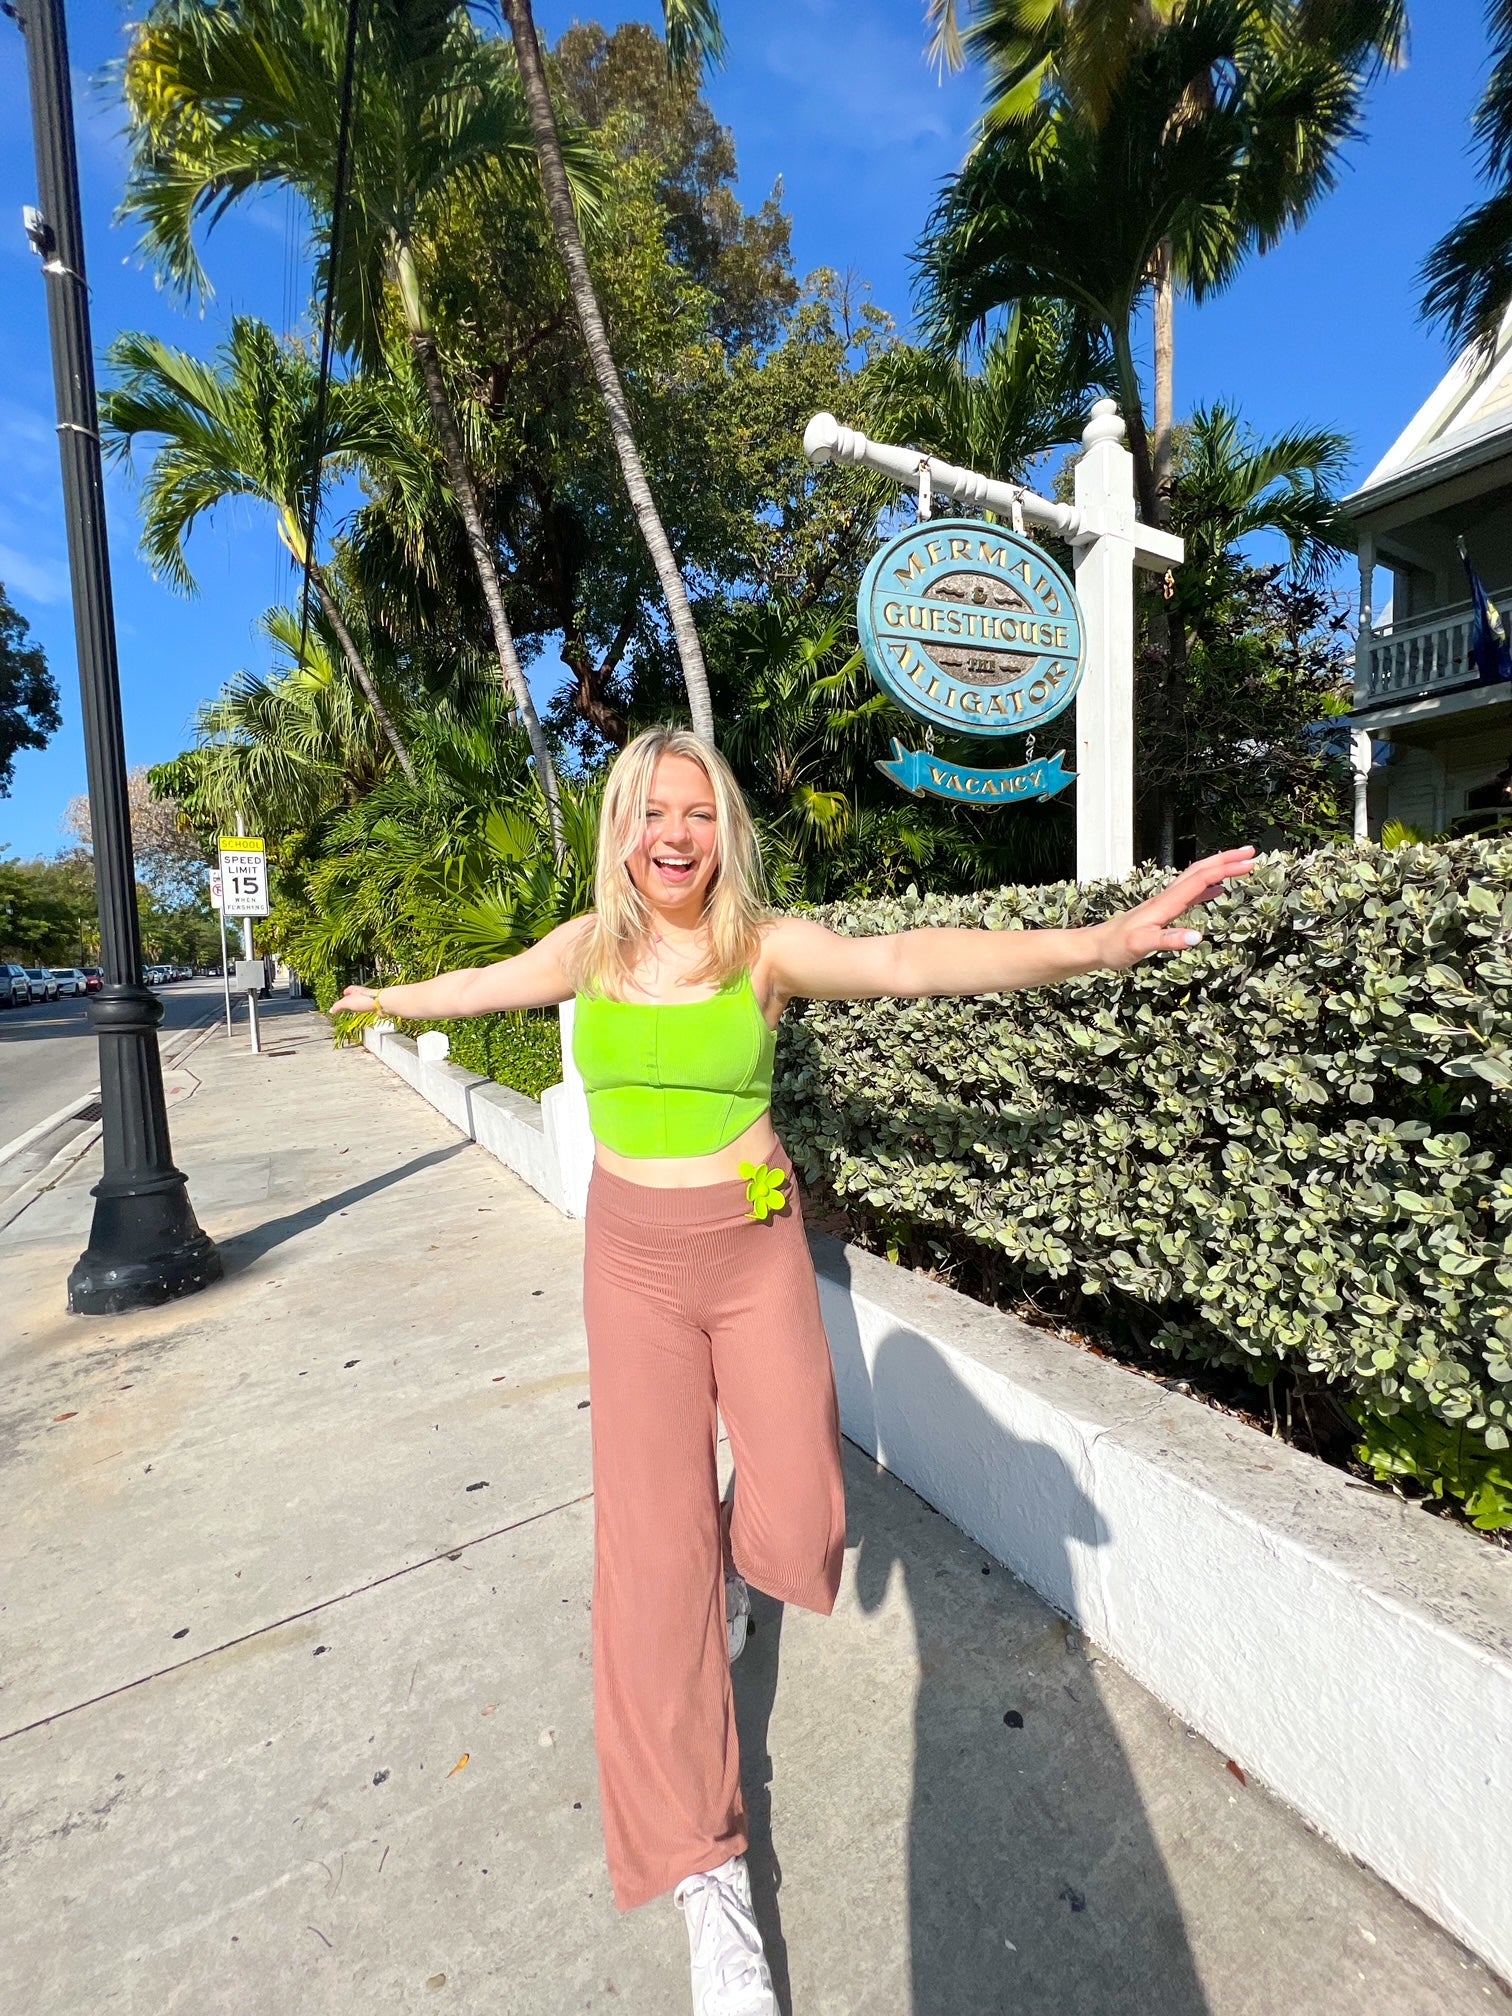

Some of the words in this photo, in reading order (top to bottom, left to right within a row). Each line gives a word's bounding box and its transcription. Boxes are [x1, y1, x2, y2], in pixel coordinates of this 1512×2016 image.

[893, 538, 1062, 616] MERMAID
[971, 587, 988, 605] &
[883, 601, 1070, 649] GUESTHOUSE
[887, 642, 1069, 716] ALLIGATOR
[930, 767, 1043, 794] VACANCY
[222, 840, 261, 849] SCHOOL
[224, 856, 261, 864] SPEED
[232, 877, 259, 895] 15
